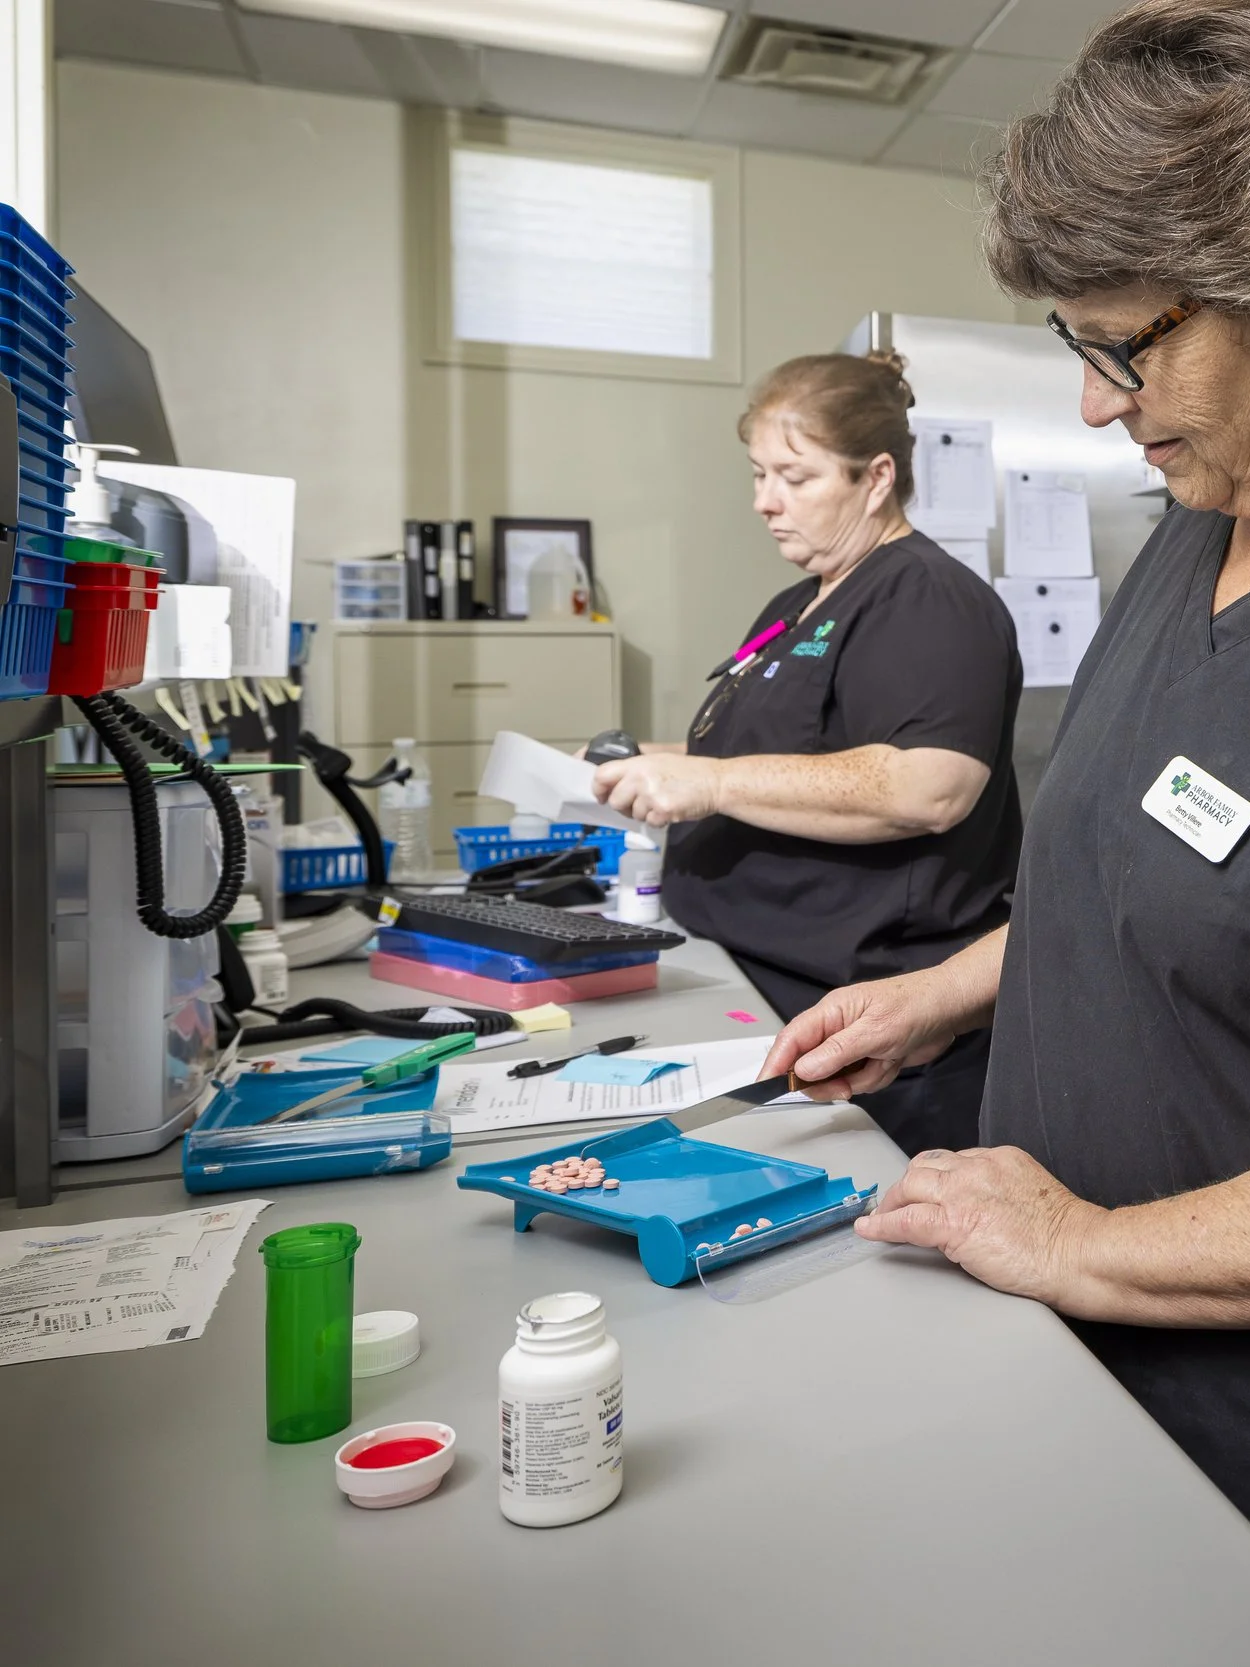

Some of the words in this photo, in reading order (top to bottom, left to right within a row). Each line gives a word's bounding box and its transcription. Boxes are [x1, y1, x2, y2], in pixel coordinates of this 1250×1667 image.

[1175, 805, 1188, 818] Betty
[1186, 791, 1232, 827] PHARMACY
[1192, 785, 1214, 803] ARBOR
[1213, 799, 1238, 818] FAMILY
